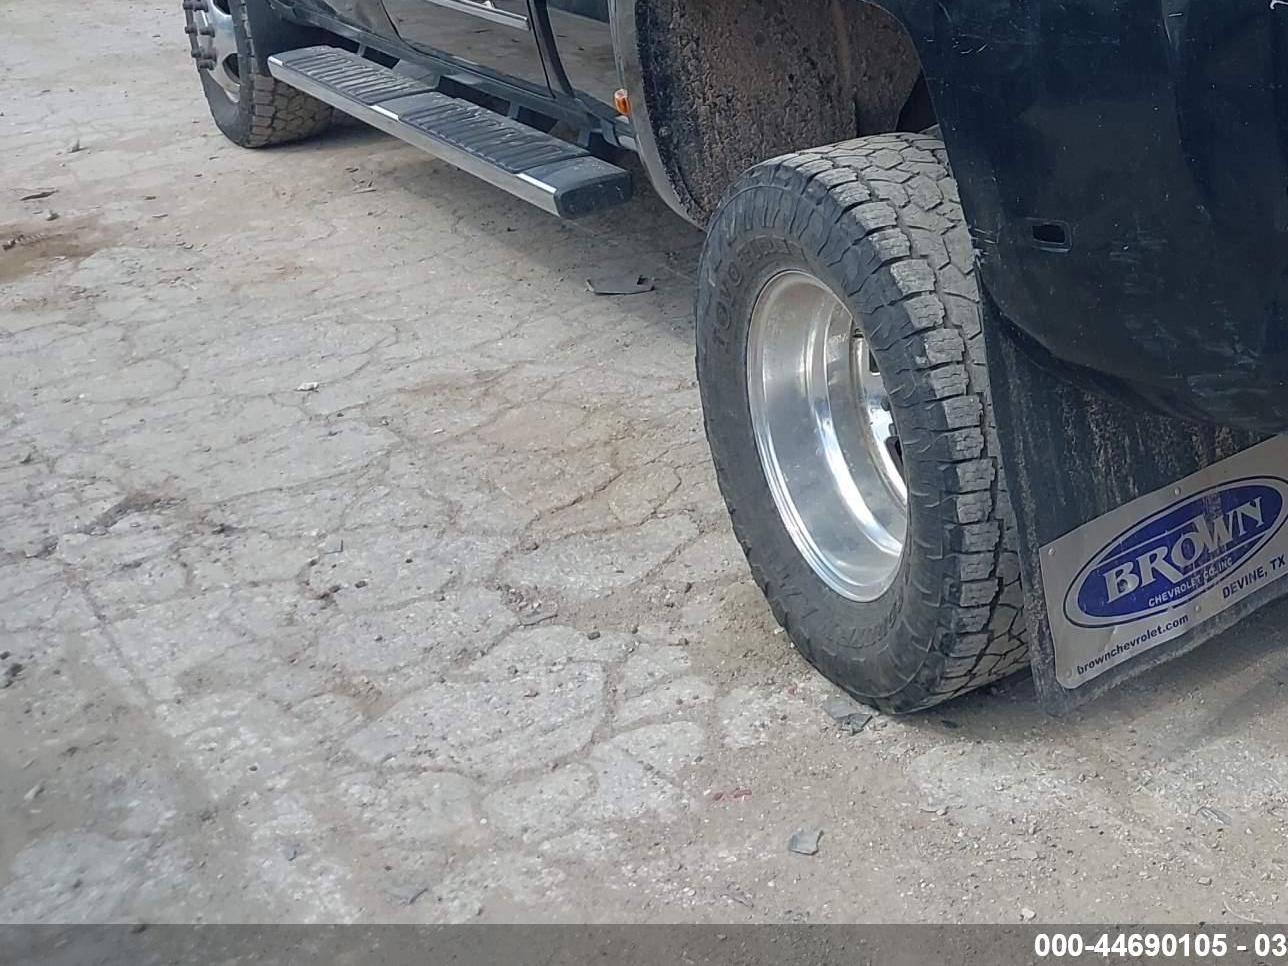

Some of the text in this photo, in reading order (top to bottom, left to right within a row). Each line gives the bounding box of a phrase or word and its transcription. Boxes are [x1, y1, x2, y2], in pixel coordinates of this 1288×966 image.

[1102, 496, 1266, 604] BROWN
[1221, 554, 1287, 599] DEVINE, TX
[1147, 574, 1202, 608] CHEVROLET
[1076, 613, 1190, 676] brownchevrolet.com
